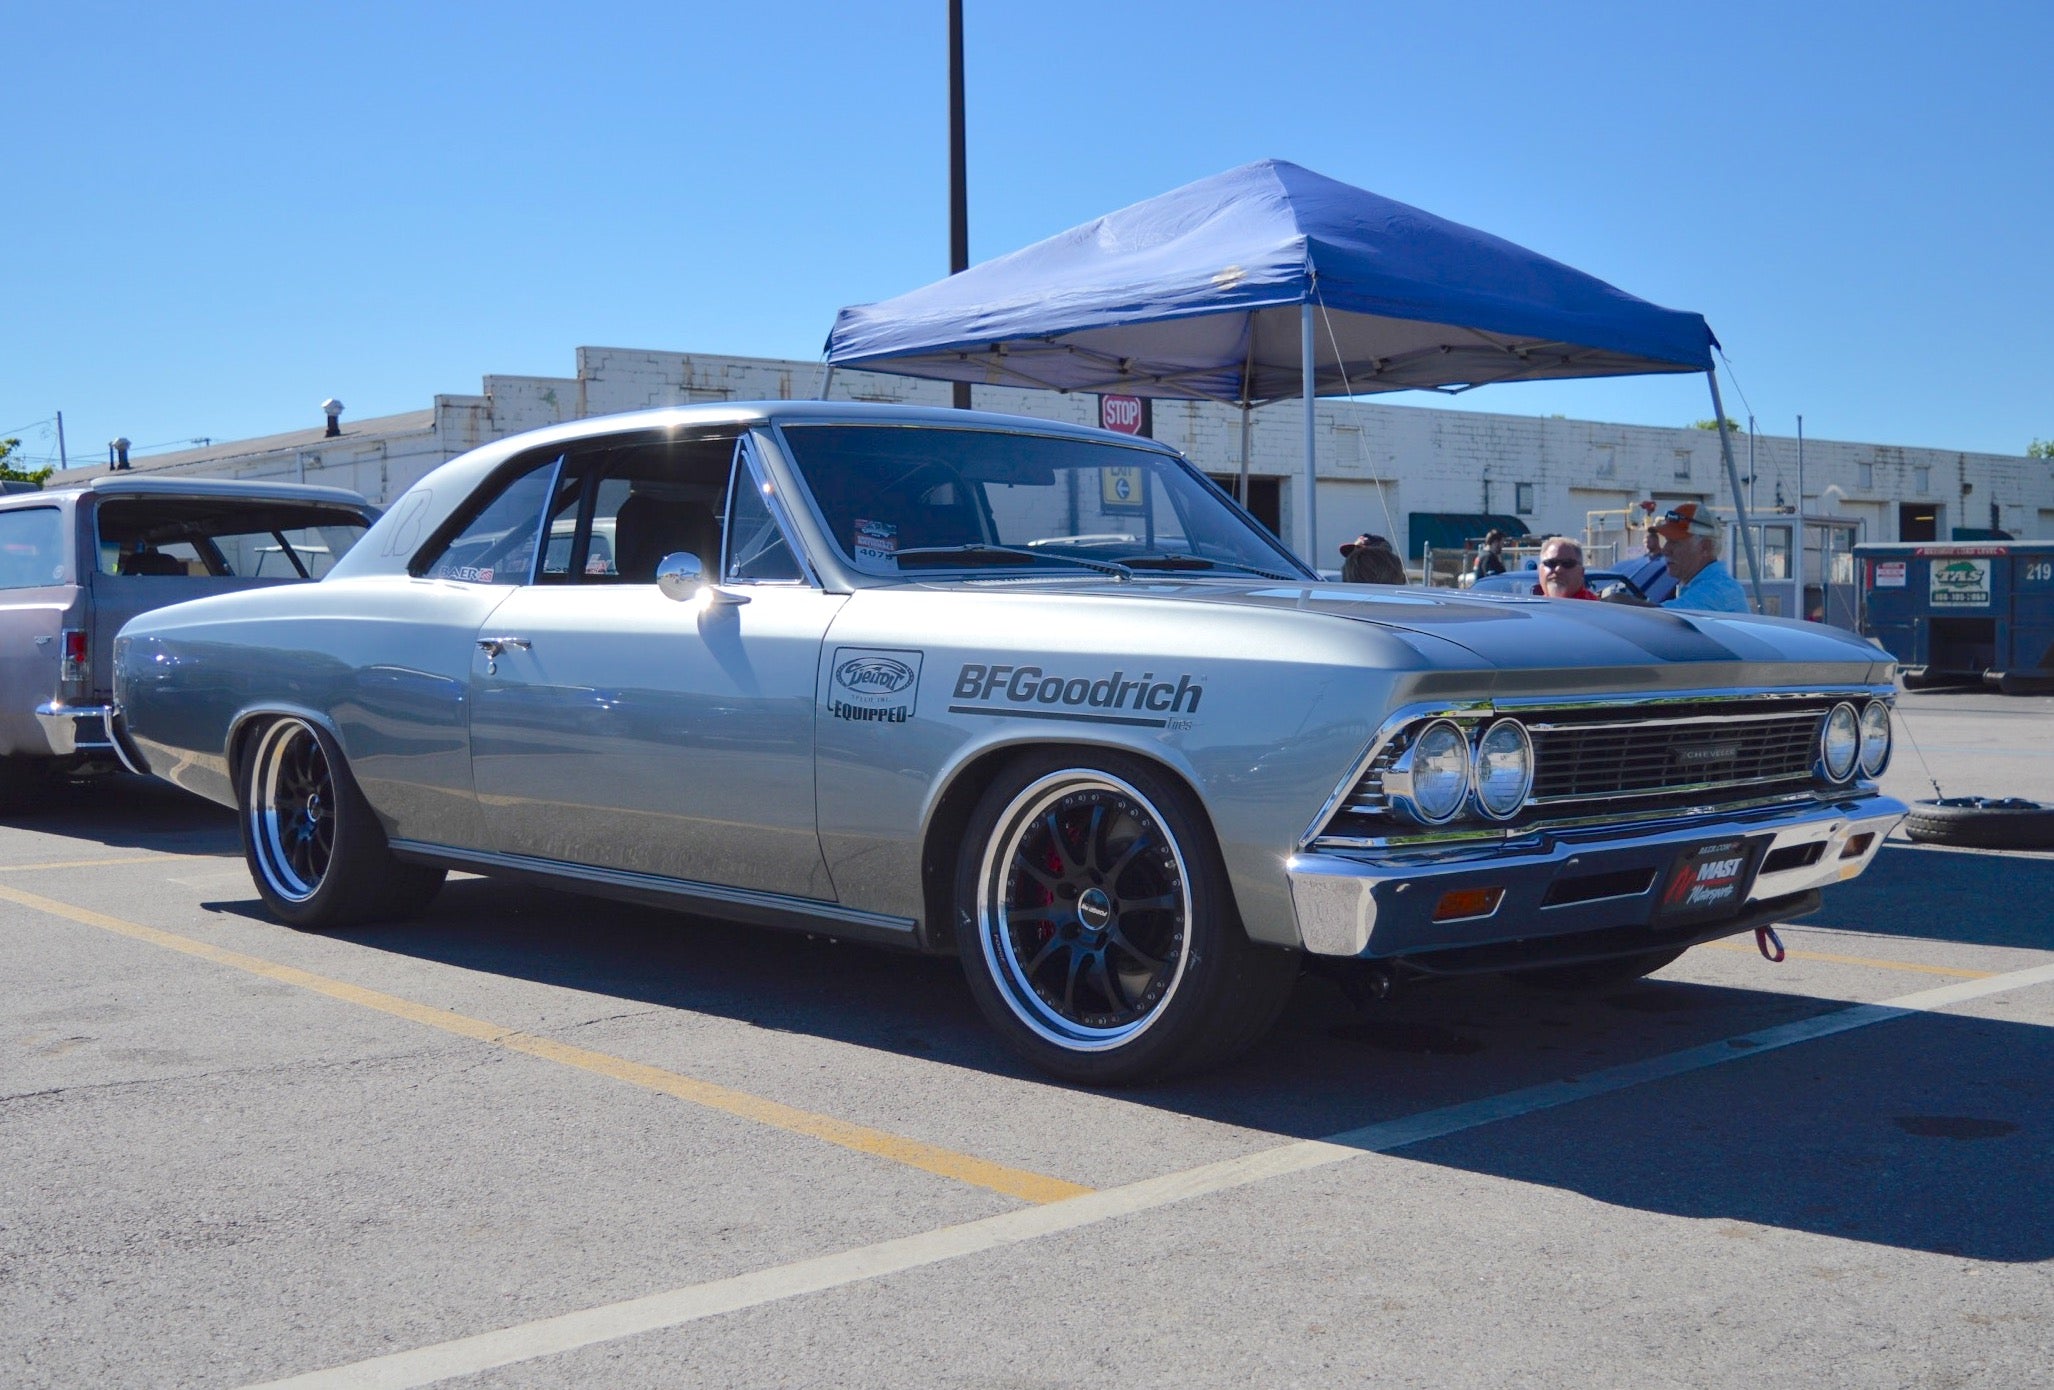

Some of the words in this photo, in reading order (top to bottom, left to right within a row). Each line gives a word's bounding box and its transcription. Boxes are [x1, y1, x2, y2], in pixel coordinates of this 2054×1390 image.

[1106, 400, 1138, 425] STOP
[440, 565, 478, 581] BAER
[1935, 570, 1985, 583] TAS
[2026, 563, 2052, 580] 219
[952, 663, 1203, 714] BFGoodrich
[834, 700, 907, 723] EQUIPPED
[1696, 857, 1743, 881] MAST
